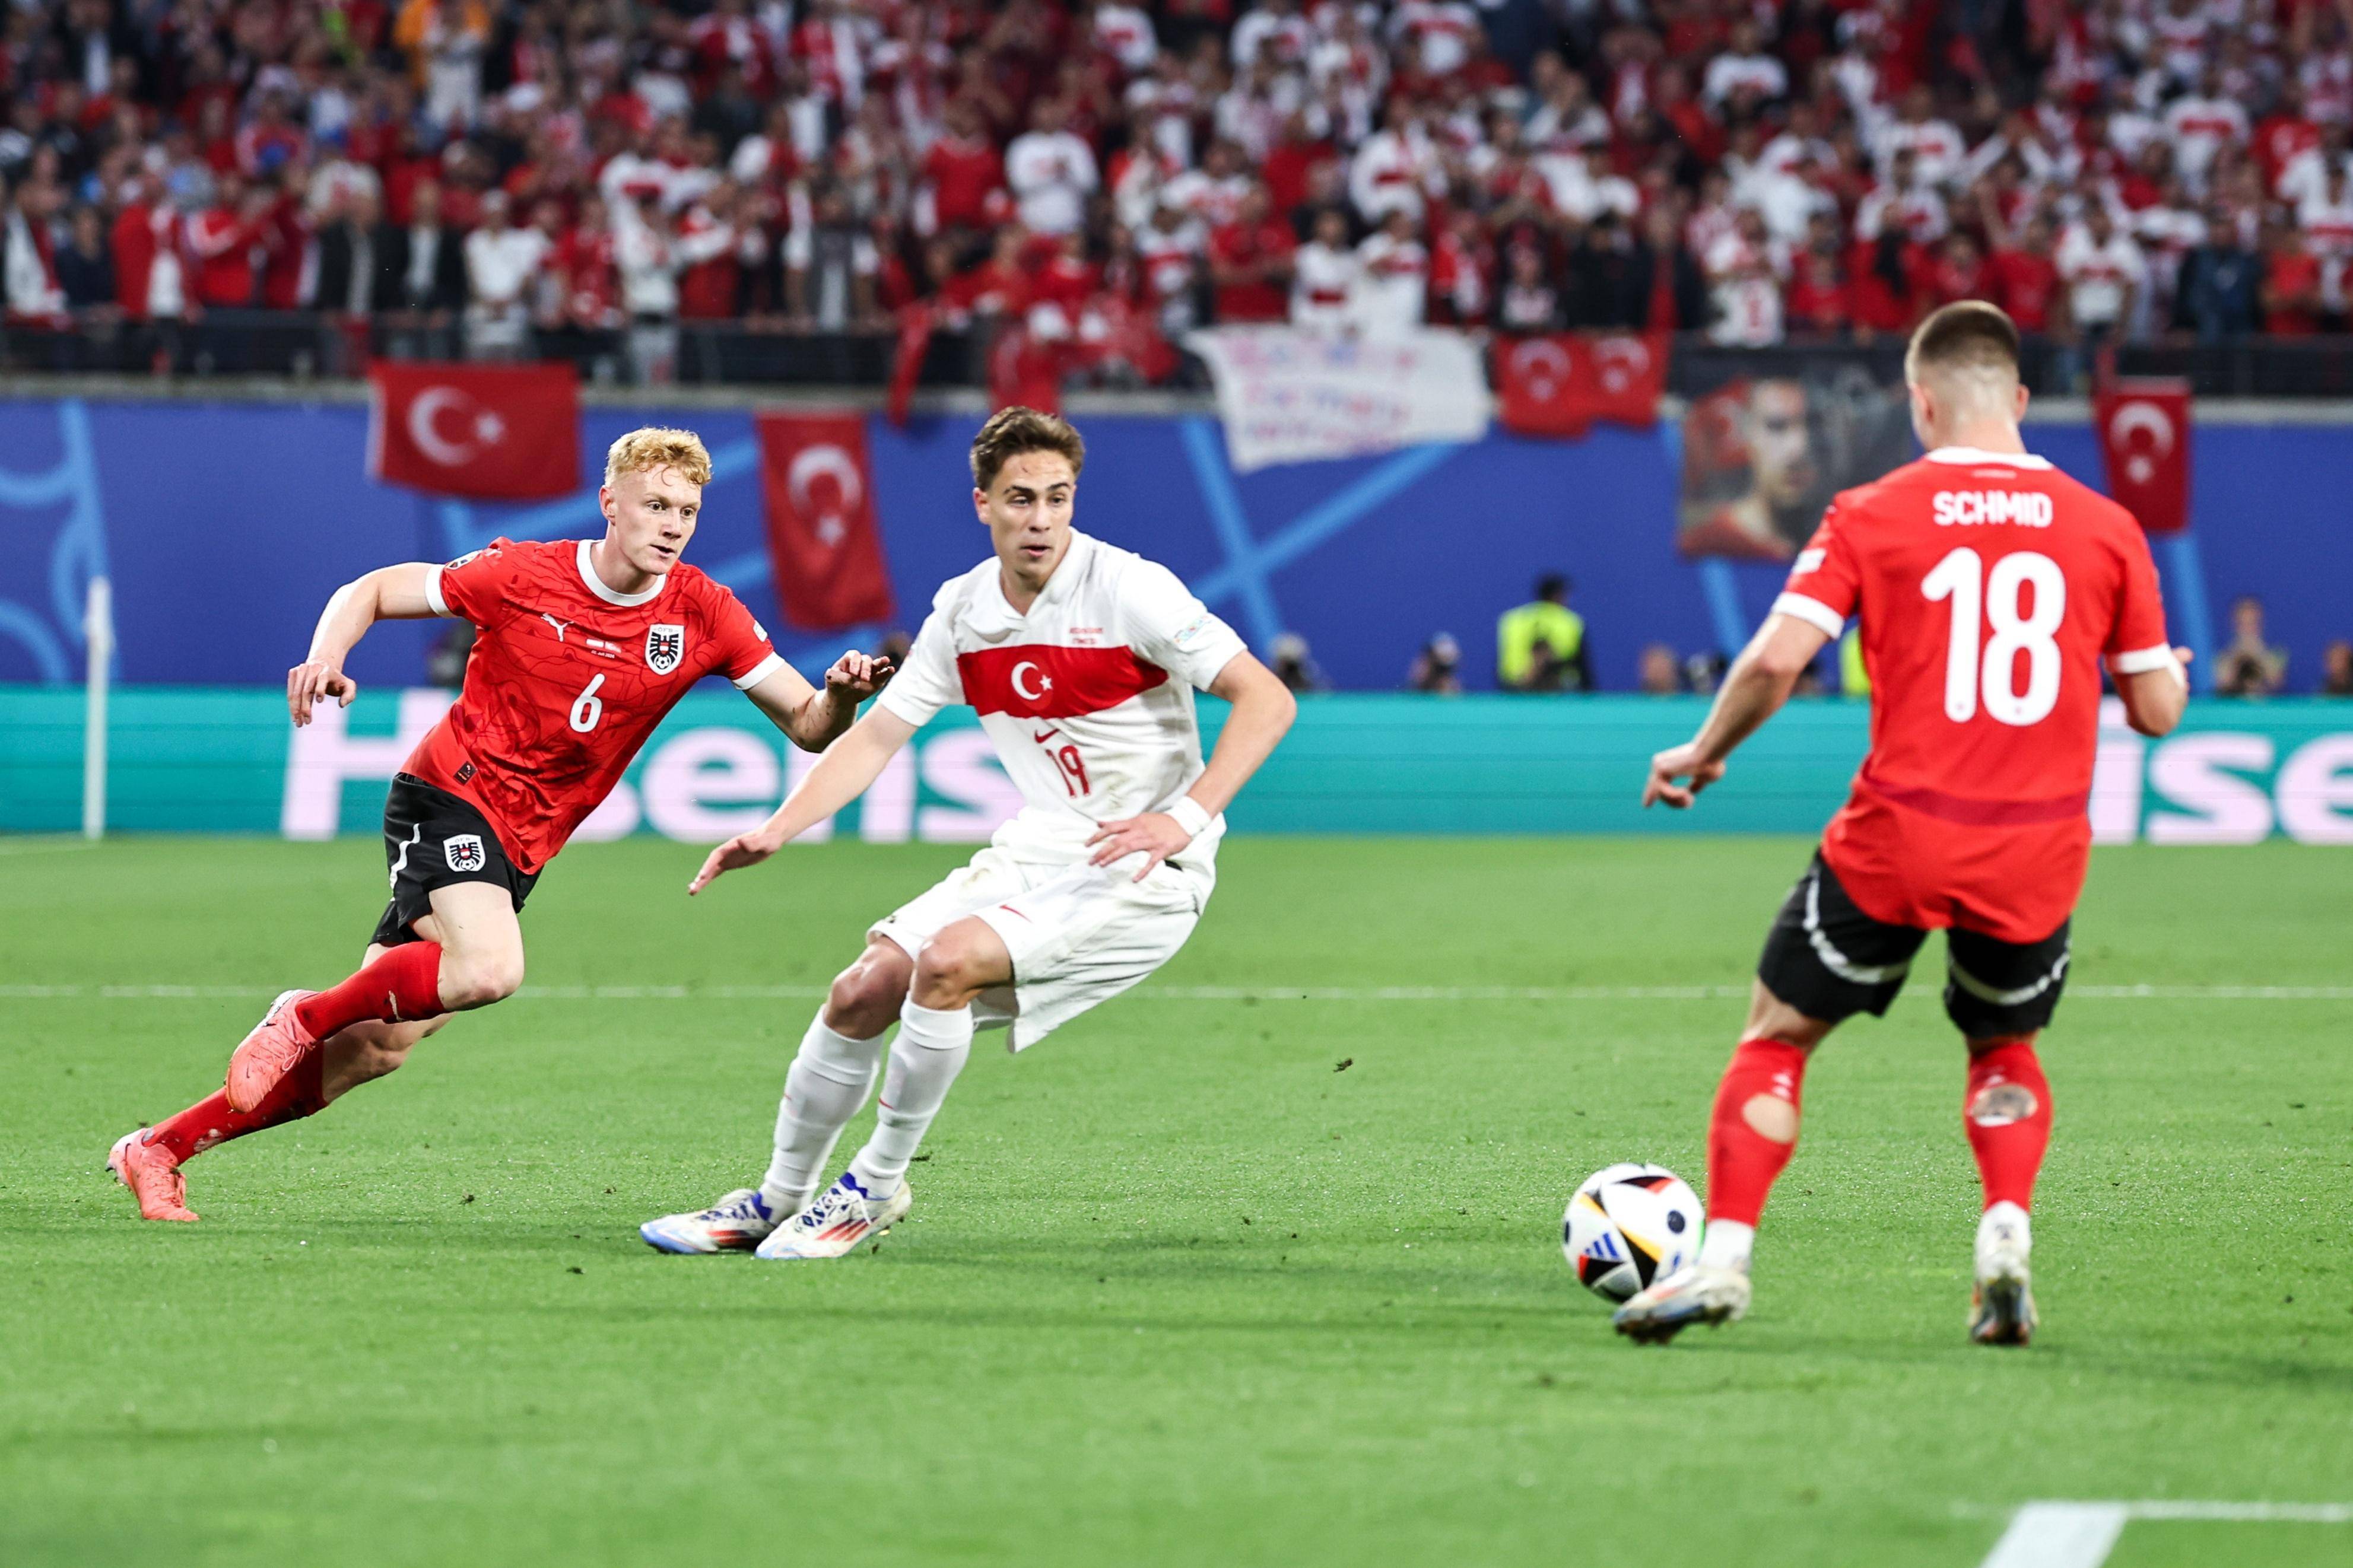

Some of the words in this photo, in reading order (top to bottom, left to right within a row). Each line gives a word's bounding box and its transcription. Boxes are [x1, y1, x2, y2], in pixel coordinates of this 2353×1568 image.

[1932, 489, 2053, 527] SCHMID
[1920, 546, 2067, 727] 18
[569, 673, 605, 733] 6
[1045, 745, 1090, 797] 19
